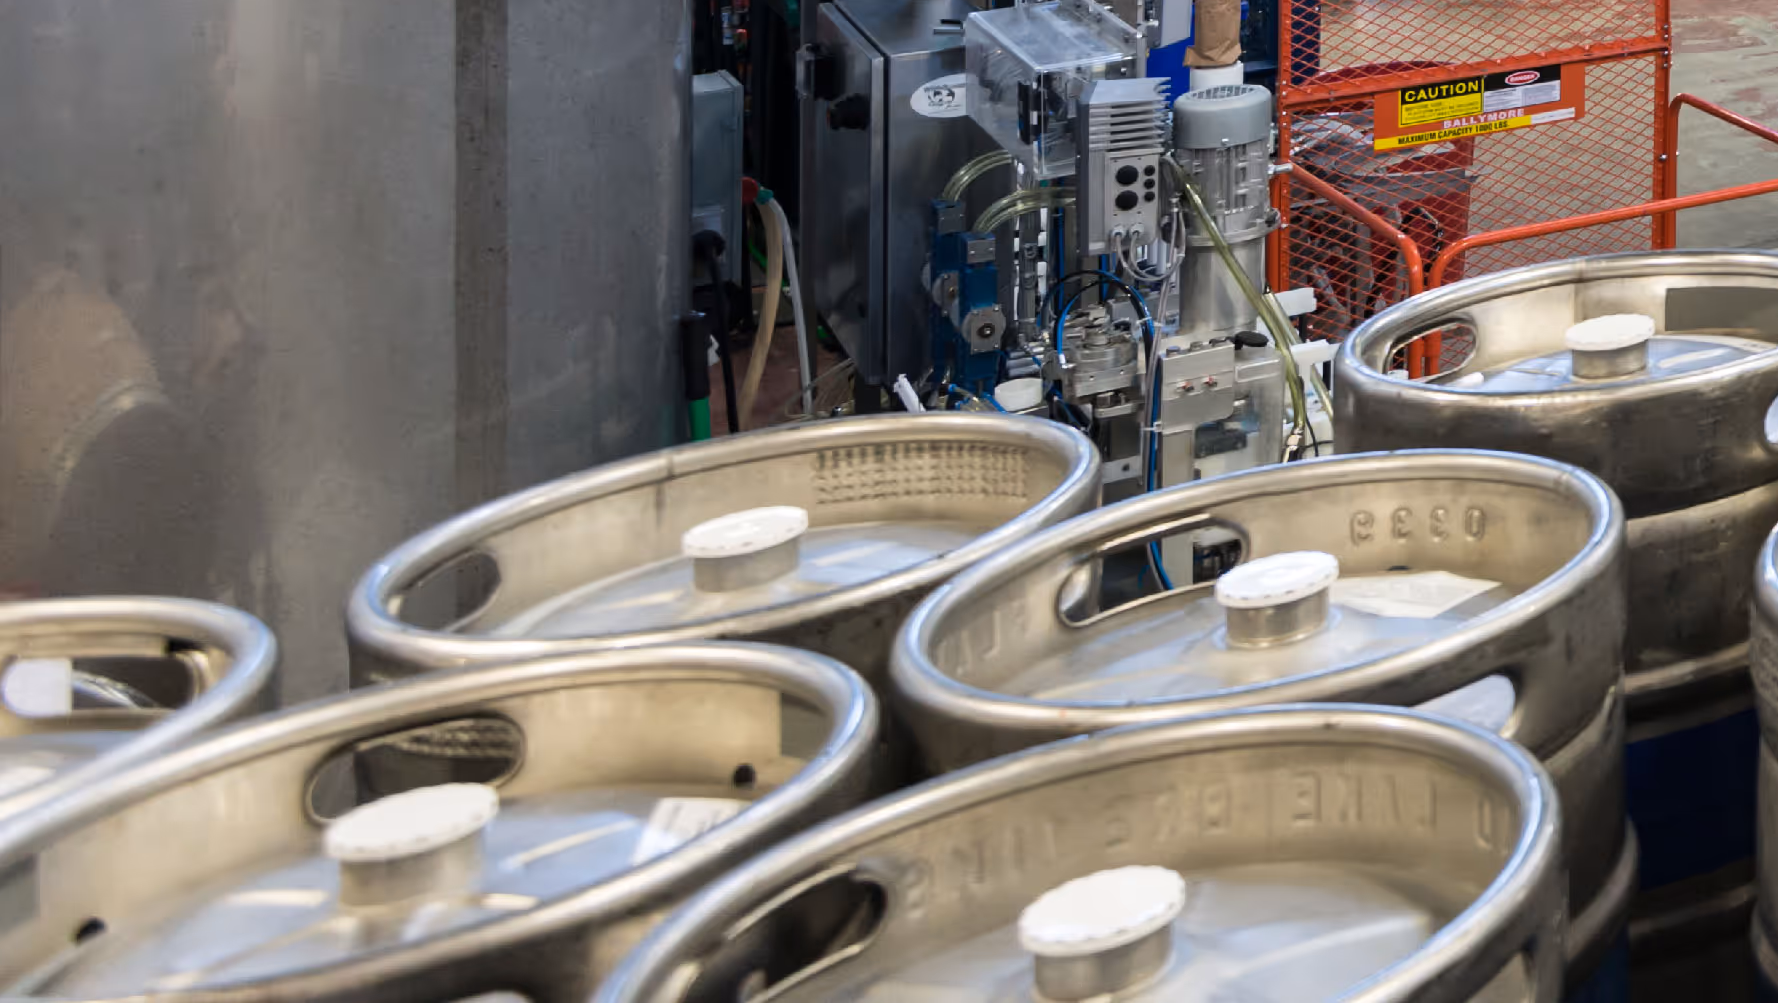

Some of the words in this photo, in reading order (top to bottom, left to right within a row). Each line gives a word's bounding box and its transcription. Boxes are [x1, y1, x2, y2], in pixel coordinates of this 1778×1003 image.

[1404, 79, 1479, 102] CAUTION
[1443, 108, 1525, 129] BALLYMORE
[1398, 132, 1437, 145] MAXIMUM
[1438, 127, 1474, 139] CAPACITY
[1475, 123, 1492, 134] 1000
